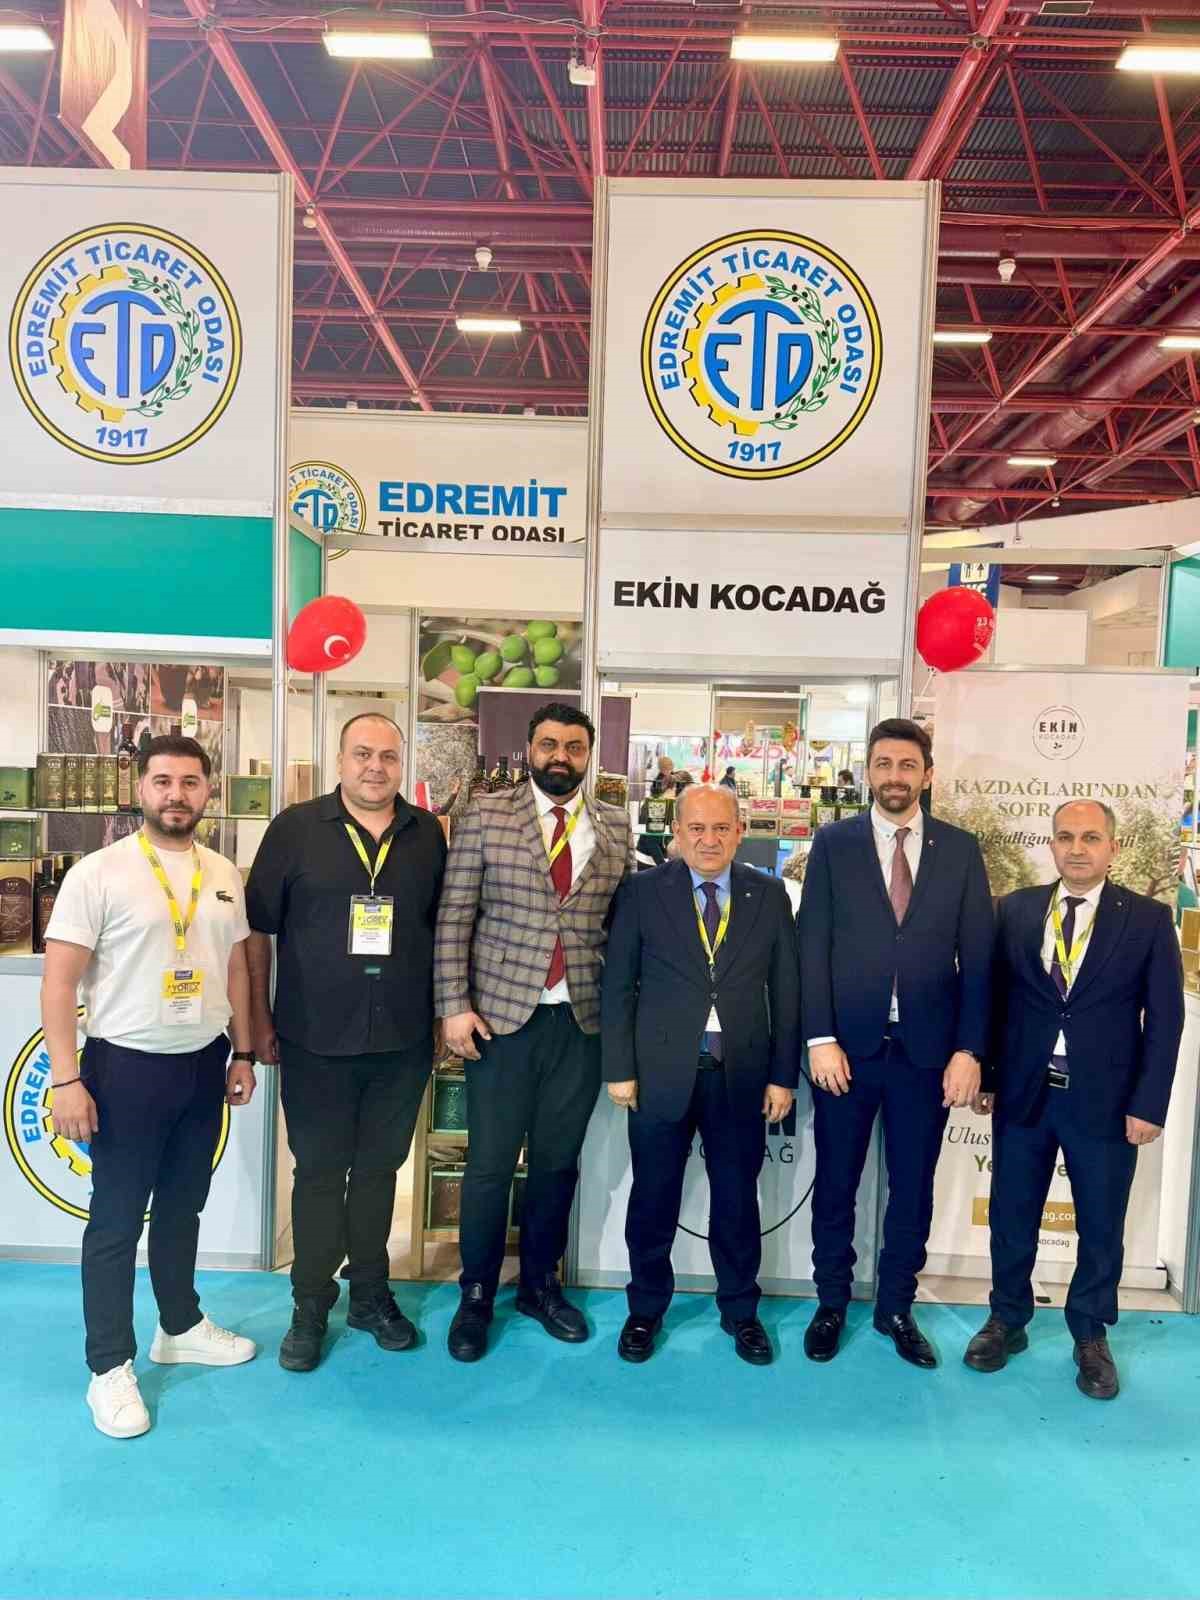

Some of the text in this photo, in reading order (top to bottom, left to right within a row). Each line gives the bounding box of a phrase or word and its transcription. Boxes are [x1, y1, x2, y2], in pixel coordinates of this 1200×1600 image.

[26, 239, 226, 384] EDREMİT TİCARET ODASI
[657, 246, 865, 395] EDREMİT TİCARET ODASI
[95, 425, 149, 448] 1917
[727, 440, 782, 462] 1917
[299, 467, 350, 490] TİCARET
[378, 479, 567, 518] EDREMİT
[378, 517, 565, 543] TİCARET ODASI
[613, 575, 886, 614] EKİN KOCADAĞ
[1039, 719, 1078, 733] EKİN
[954, 777, 1159, 799] KAZDAĞLARI'NDAN
[21, 1052, 52, 1143] EDREM
